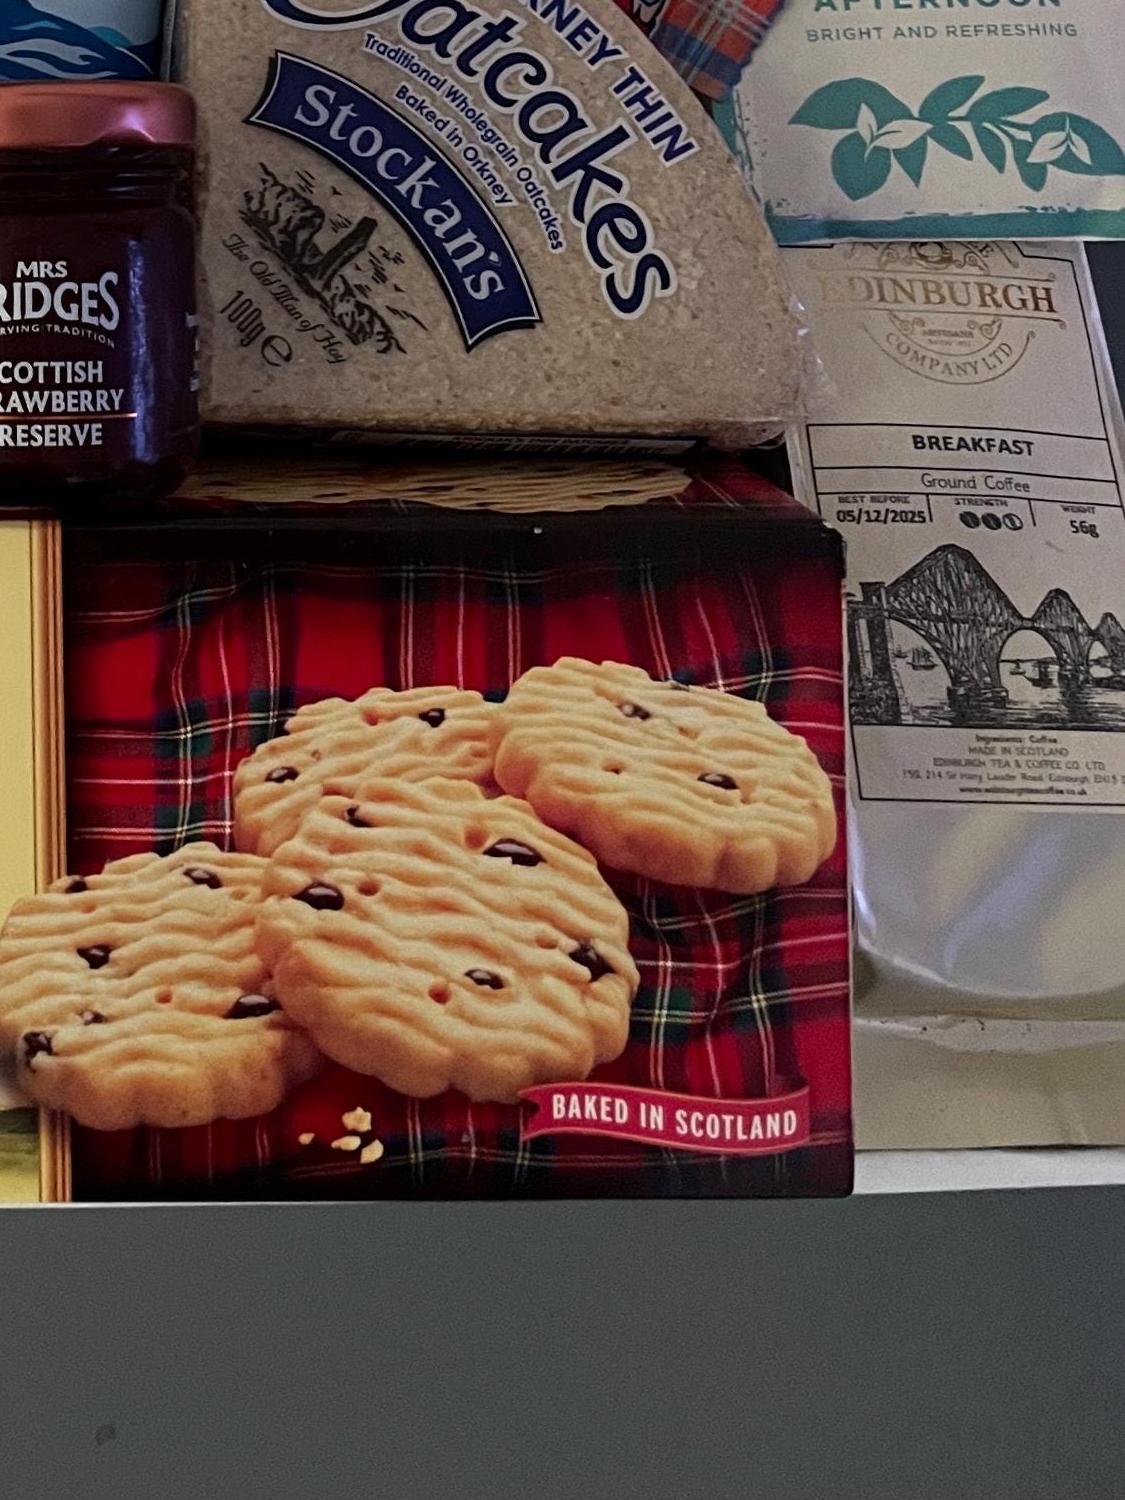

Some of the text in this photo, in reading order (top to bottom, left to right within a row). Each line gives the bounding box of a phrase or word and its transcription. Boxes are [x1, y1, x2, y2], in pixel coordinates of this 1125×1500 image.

[805, 22, 1078, 44] BRIGHT AND REFRESHING
[612, 69, 697, 164] THIN
[364, 32, 564, 251] Traditional Wholegrain Oatcakes
[395, 84, 514, 206] Baked in Orkney
[294, 84, 506, 303] Stockan's
[16, 261, 68, 278] MRS
[222, 233, 250, 262] The
[249, 260, 282, 287] Old
[269, 284, 301, 321] Man
[313, 328, 348, 365] Hoy
[45, 323, 116, 349] TRADITION
[885, 332, 1013, 376] COMPANY LTD
[911, 434, 1035, 457] BREAKFAST
[921, 472, 1031, 493] Ground Coffee
[836, 509, 926, 524] 05/12/2025
[1069, 519, 1100, 539] 56g
[552, 1093, 798, 1141] BAKED IN SCOTLAND
